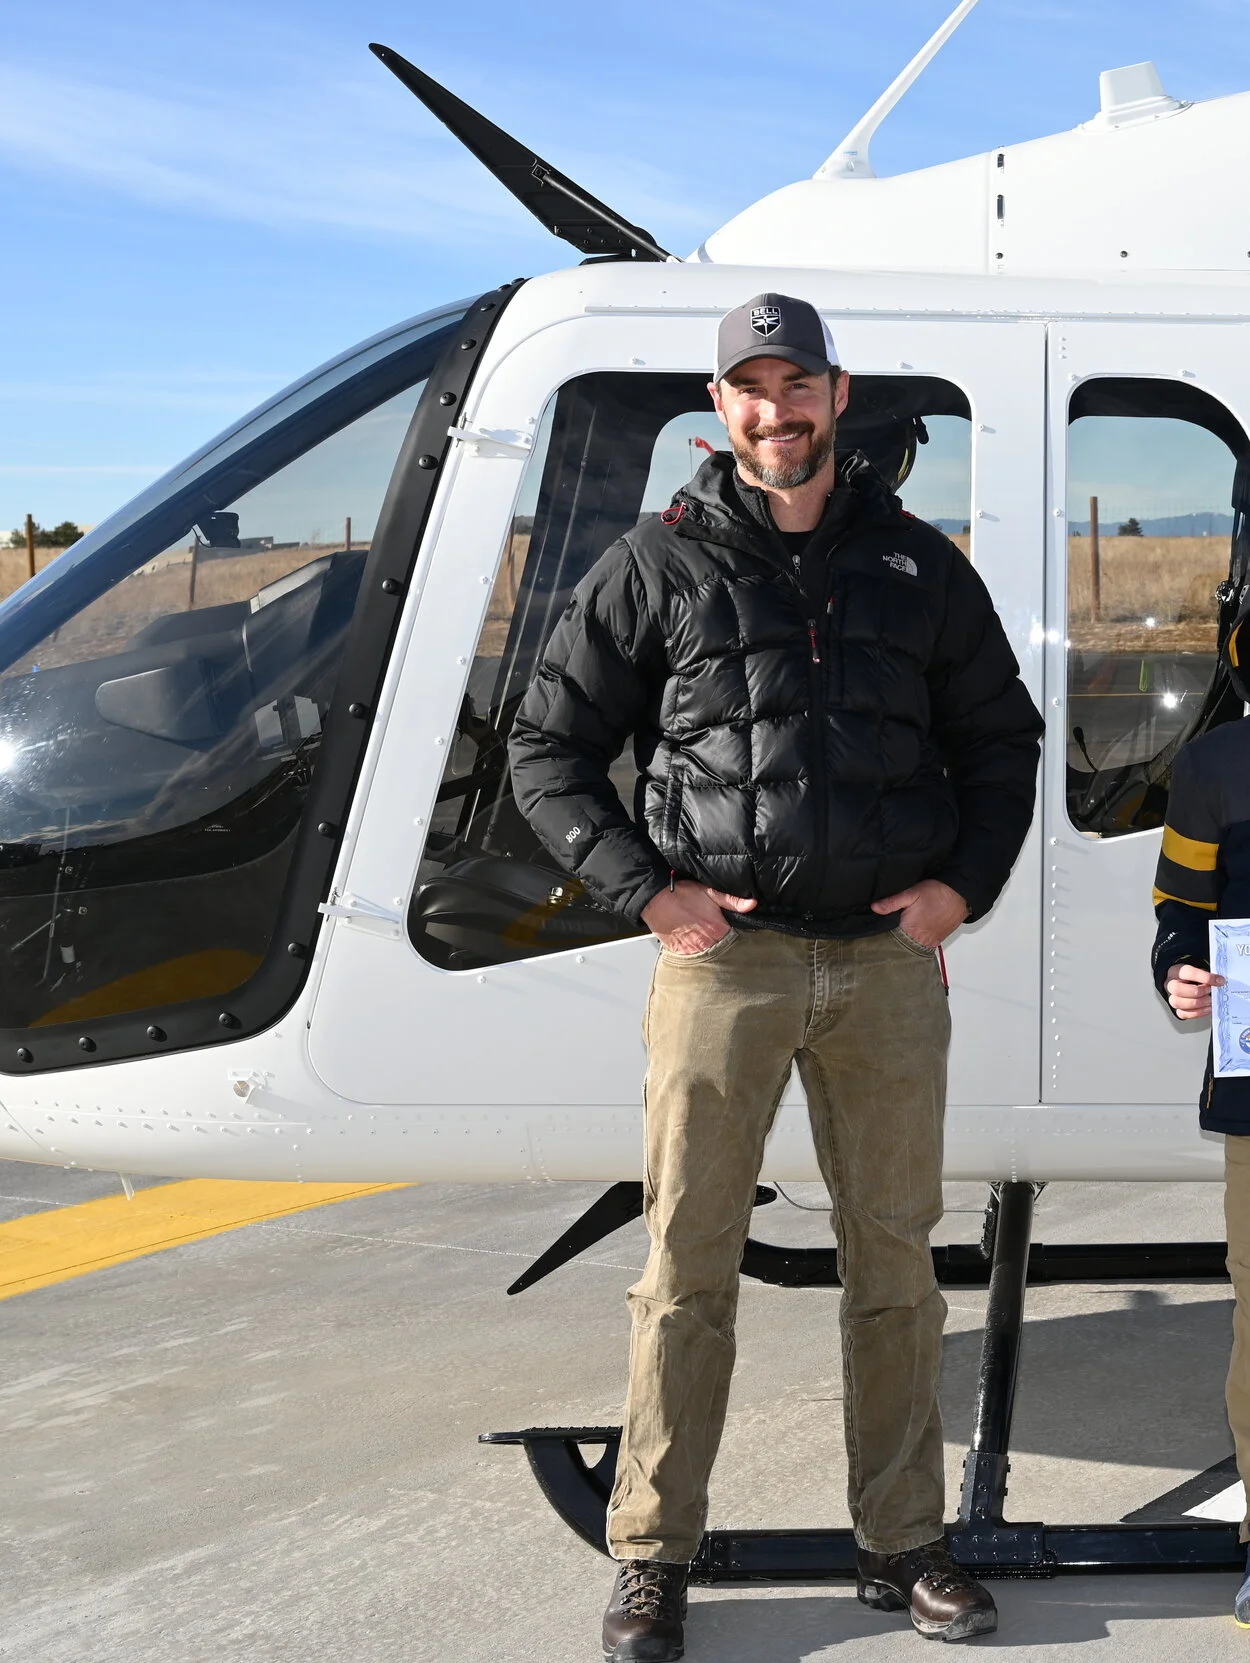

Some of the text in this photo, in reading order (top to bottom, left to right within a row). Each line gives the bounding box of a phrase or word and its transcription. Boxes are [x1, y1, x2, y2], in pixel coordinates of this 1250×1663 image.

[753, 308, 778, 316] BELL
[882, 555, 907, 566] NORTH
[889, 562, 907, 572] FACE
[565, 826, 580, 843] 800
